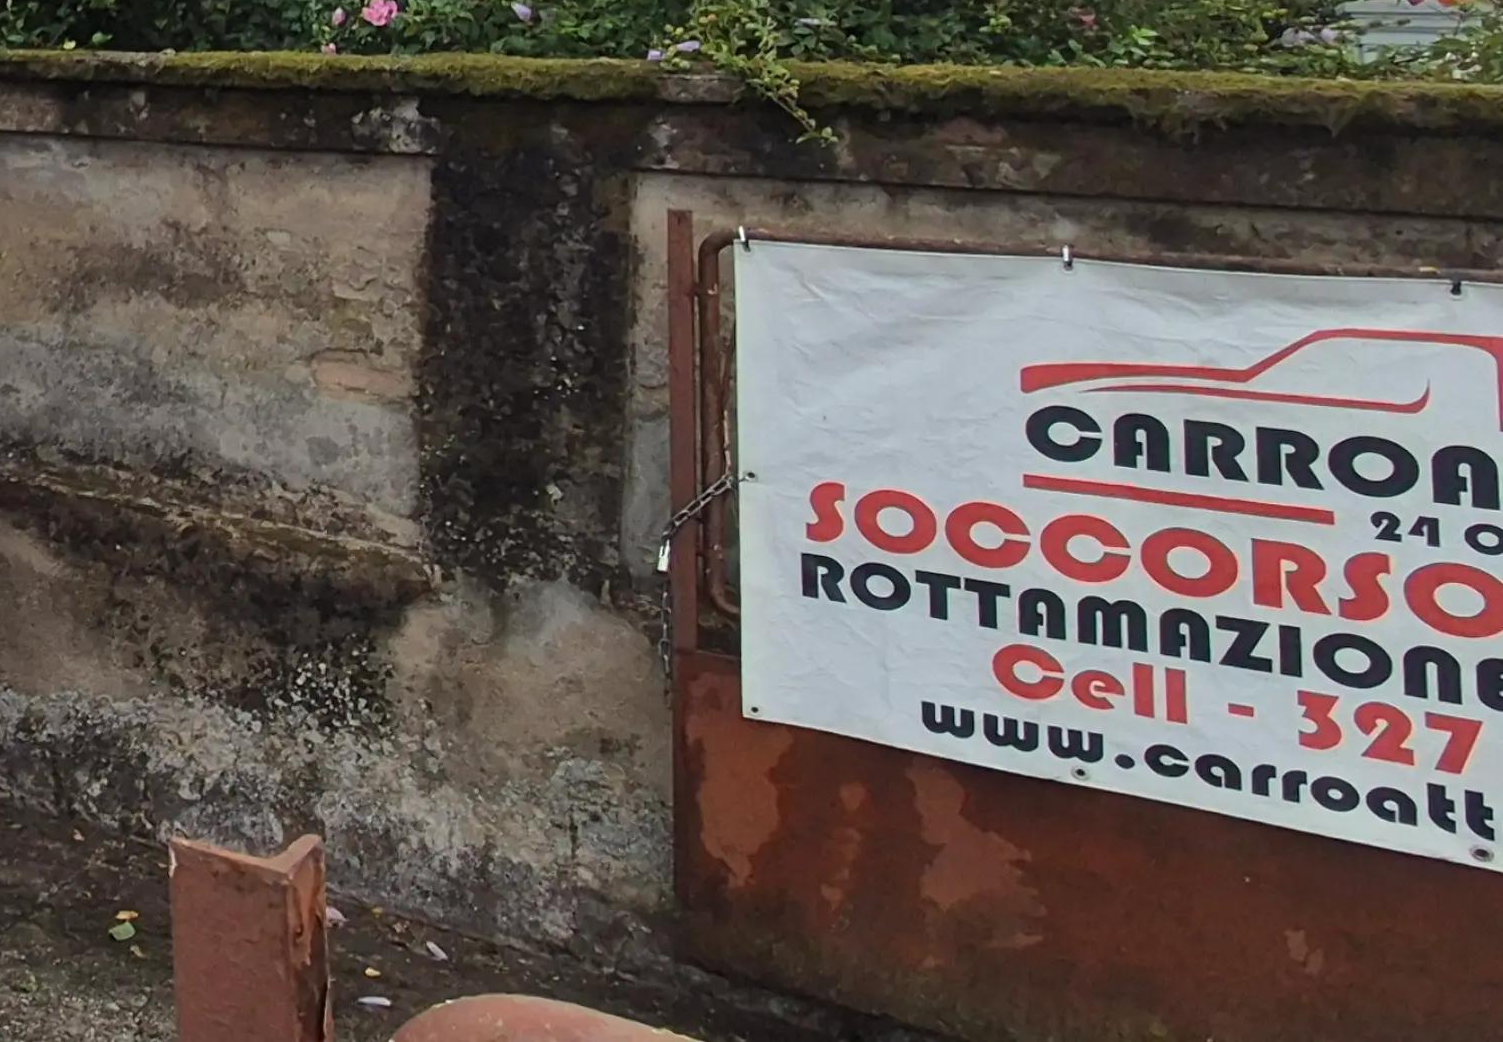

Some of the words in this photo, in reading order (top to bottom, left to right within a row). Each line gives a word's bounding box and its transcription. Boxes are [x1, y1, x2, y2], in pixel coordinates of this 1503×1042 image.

[1025, 405, 1501, 512] CARROA
[806, 480, 1503, 639] SOCCORSO
[1370, 510, 1441, 548] 24
[921, 700, 1496, 842] www.carroatt
[992, 643, 1188, 725] Cell
[1296, 689, 1483, 775] 327
